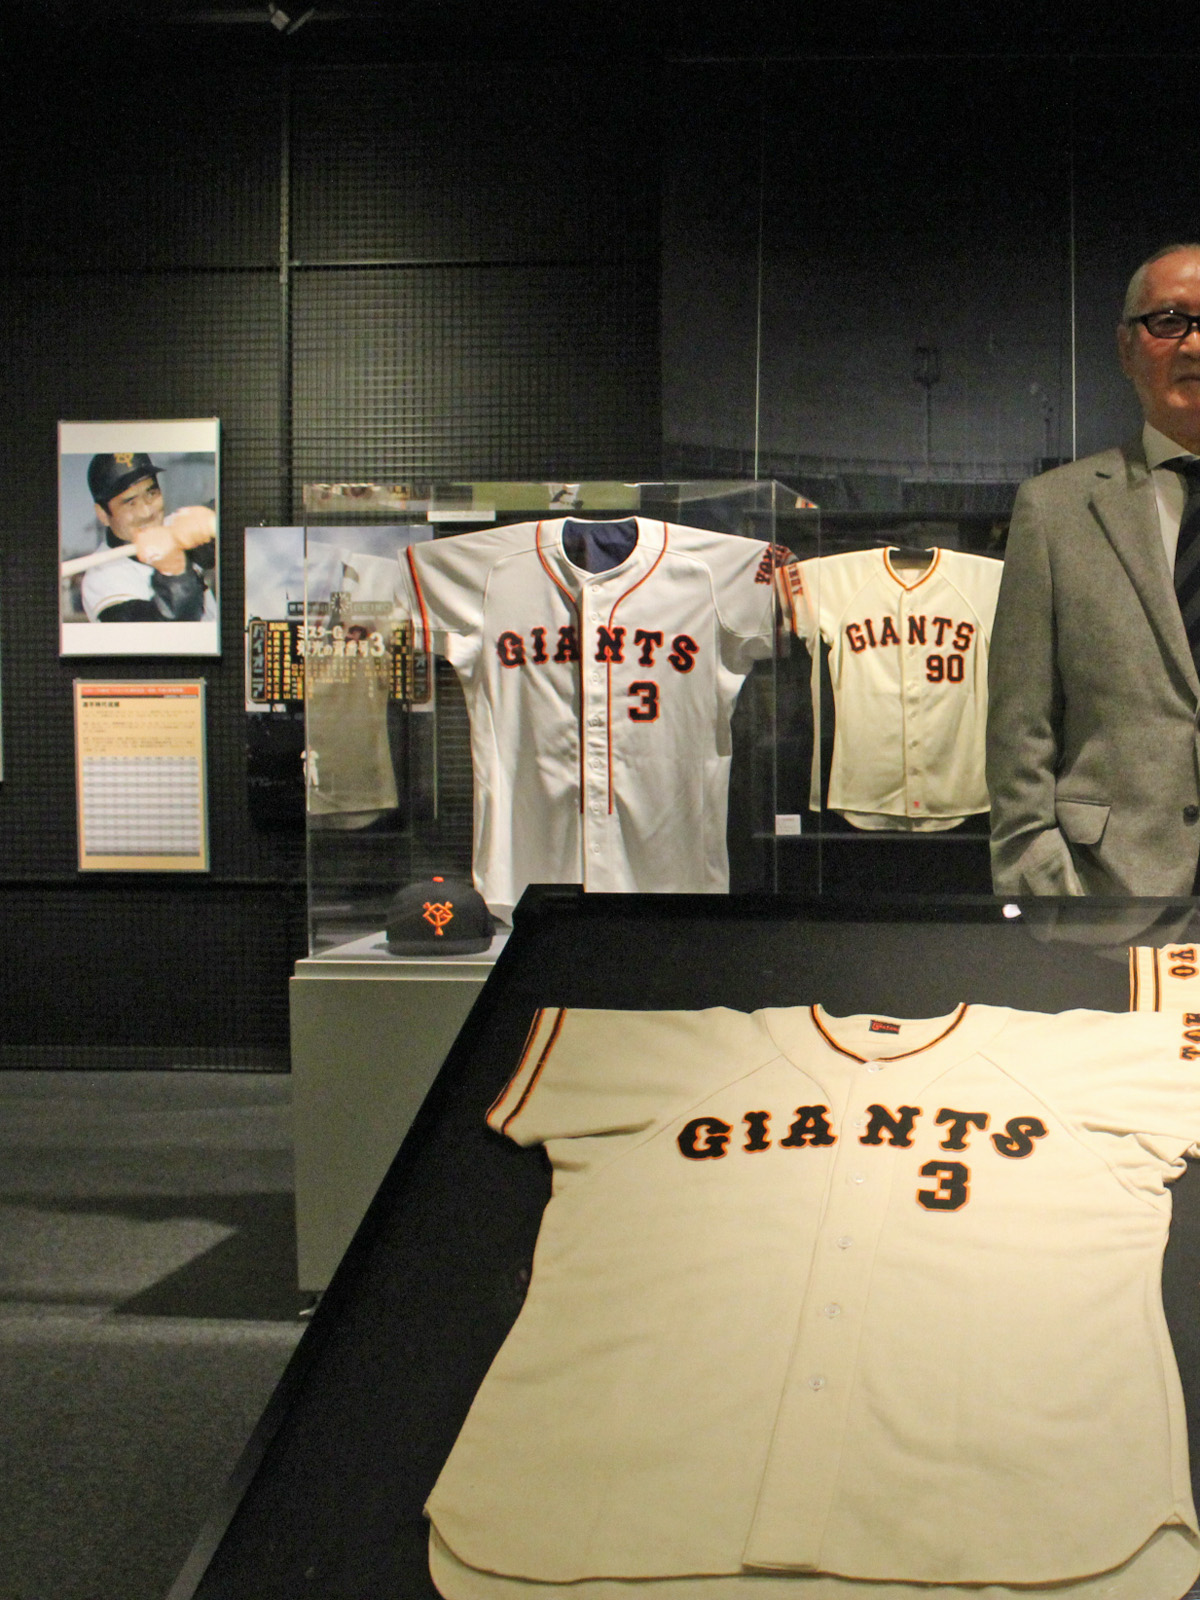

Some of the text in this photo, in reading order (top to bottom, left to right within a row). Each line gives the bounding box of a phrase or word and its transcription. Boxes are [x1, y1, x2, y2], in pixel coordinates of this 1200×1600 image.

[497, 624, 700, 674] GIANTS
[845, 615, 975, 654] GIANTS
[926, 654, 964, 683] 90
[627, 680, 660, 723] 3
[676, 1103, 1050, 1161] GIANTS
[915, 1159, 971, 1212] 3
